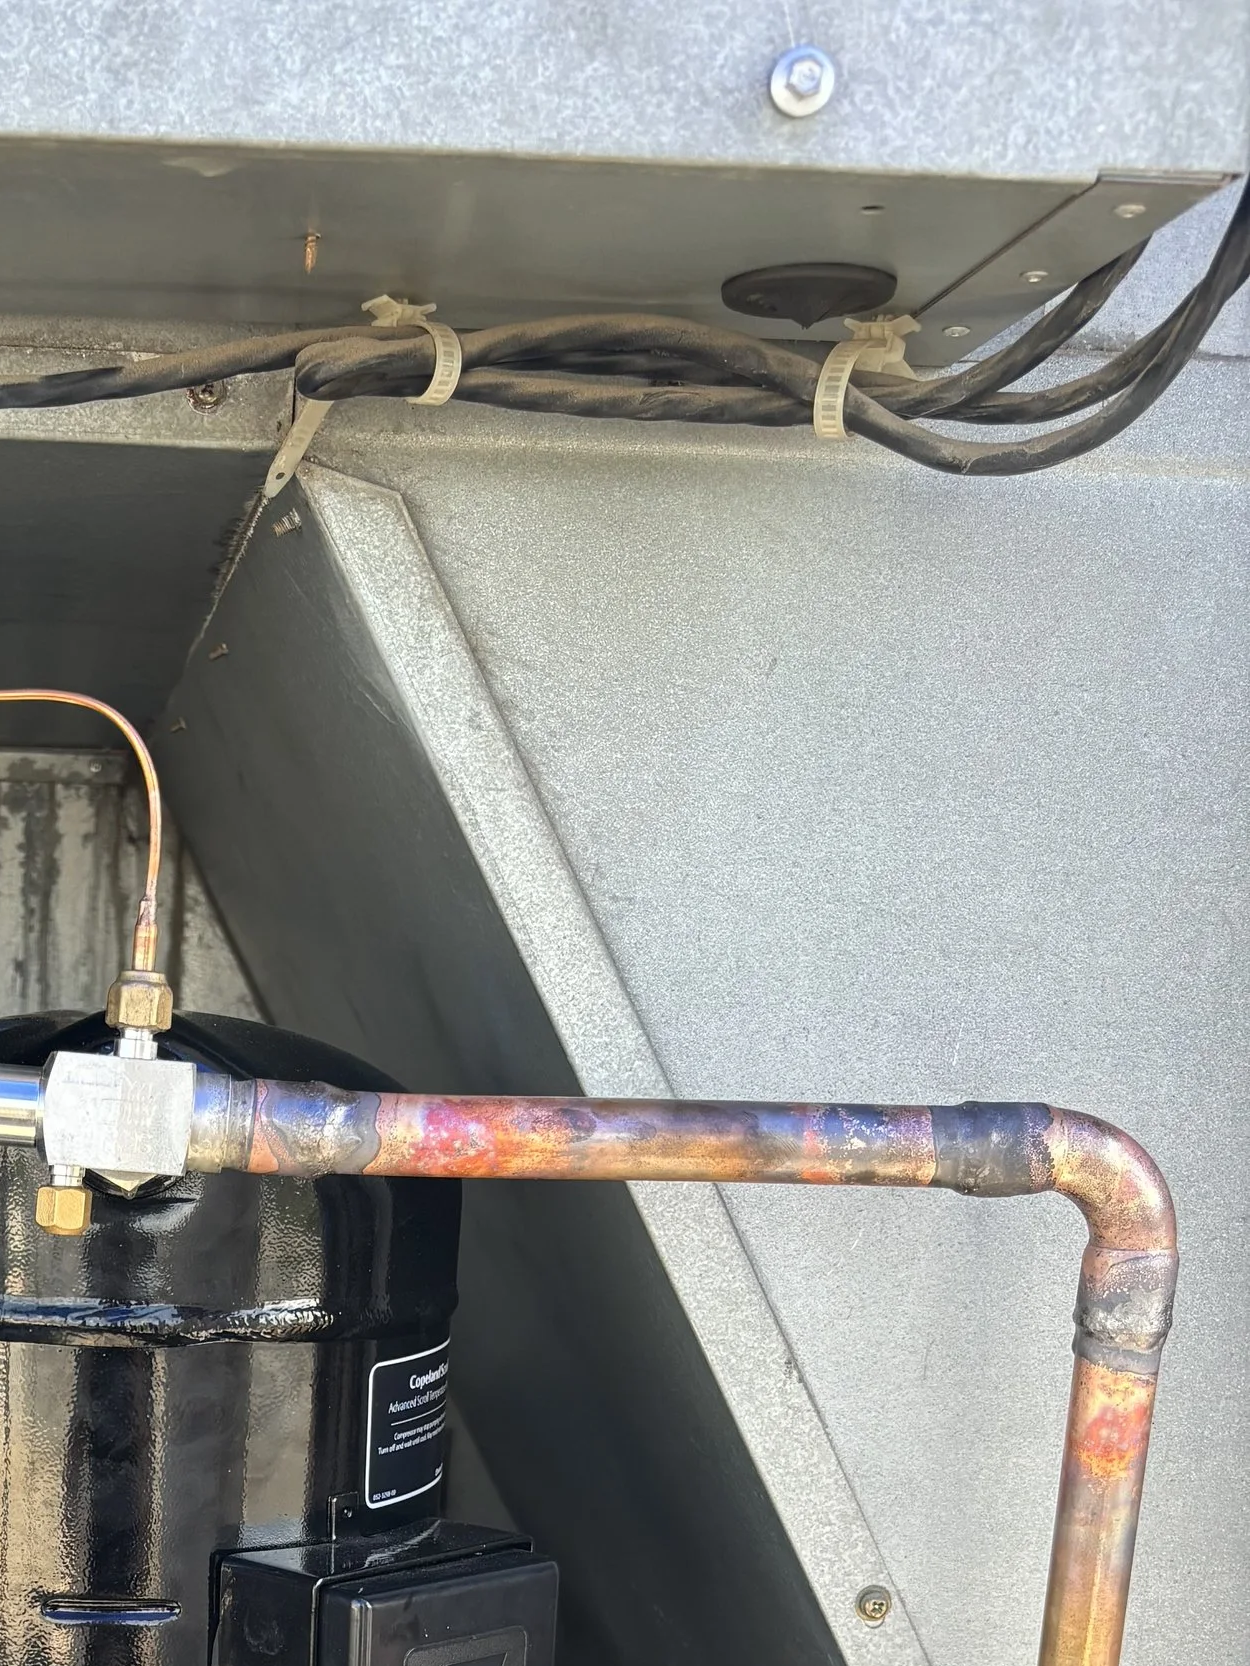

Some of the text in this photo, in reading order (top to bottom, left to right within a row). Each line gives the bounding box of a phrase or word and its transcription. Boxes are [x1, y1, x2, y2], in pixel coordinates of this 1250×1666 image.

[410, 1368, 441, 1390] Copeland
[388, 1396, 417, 1414] Advanced
[417, 1391, 429, 1407] Scroll
[378, 1446, 389, 1456] Turn
